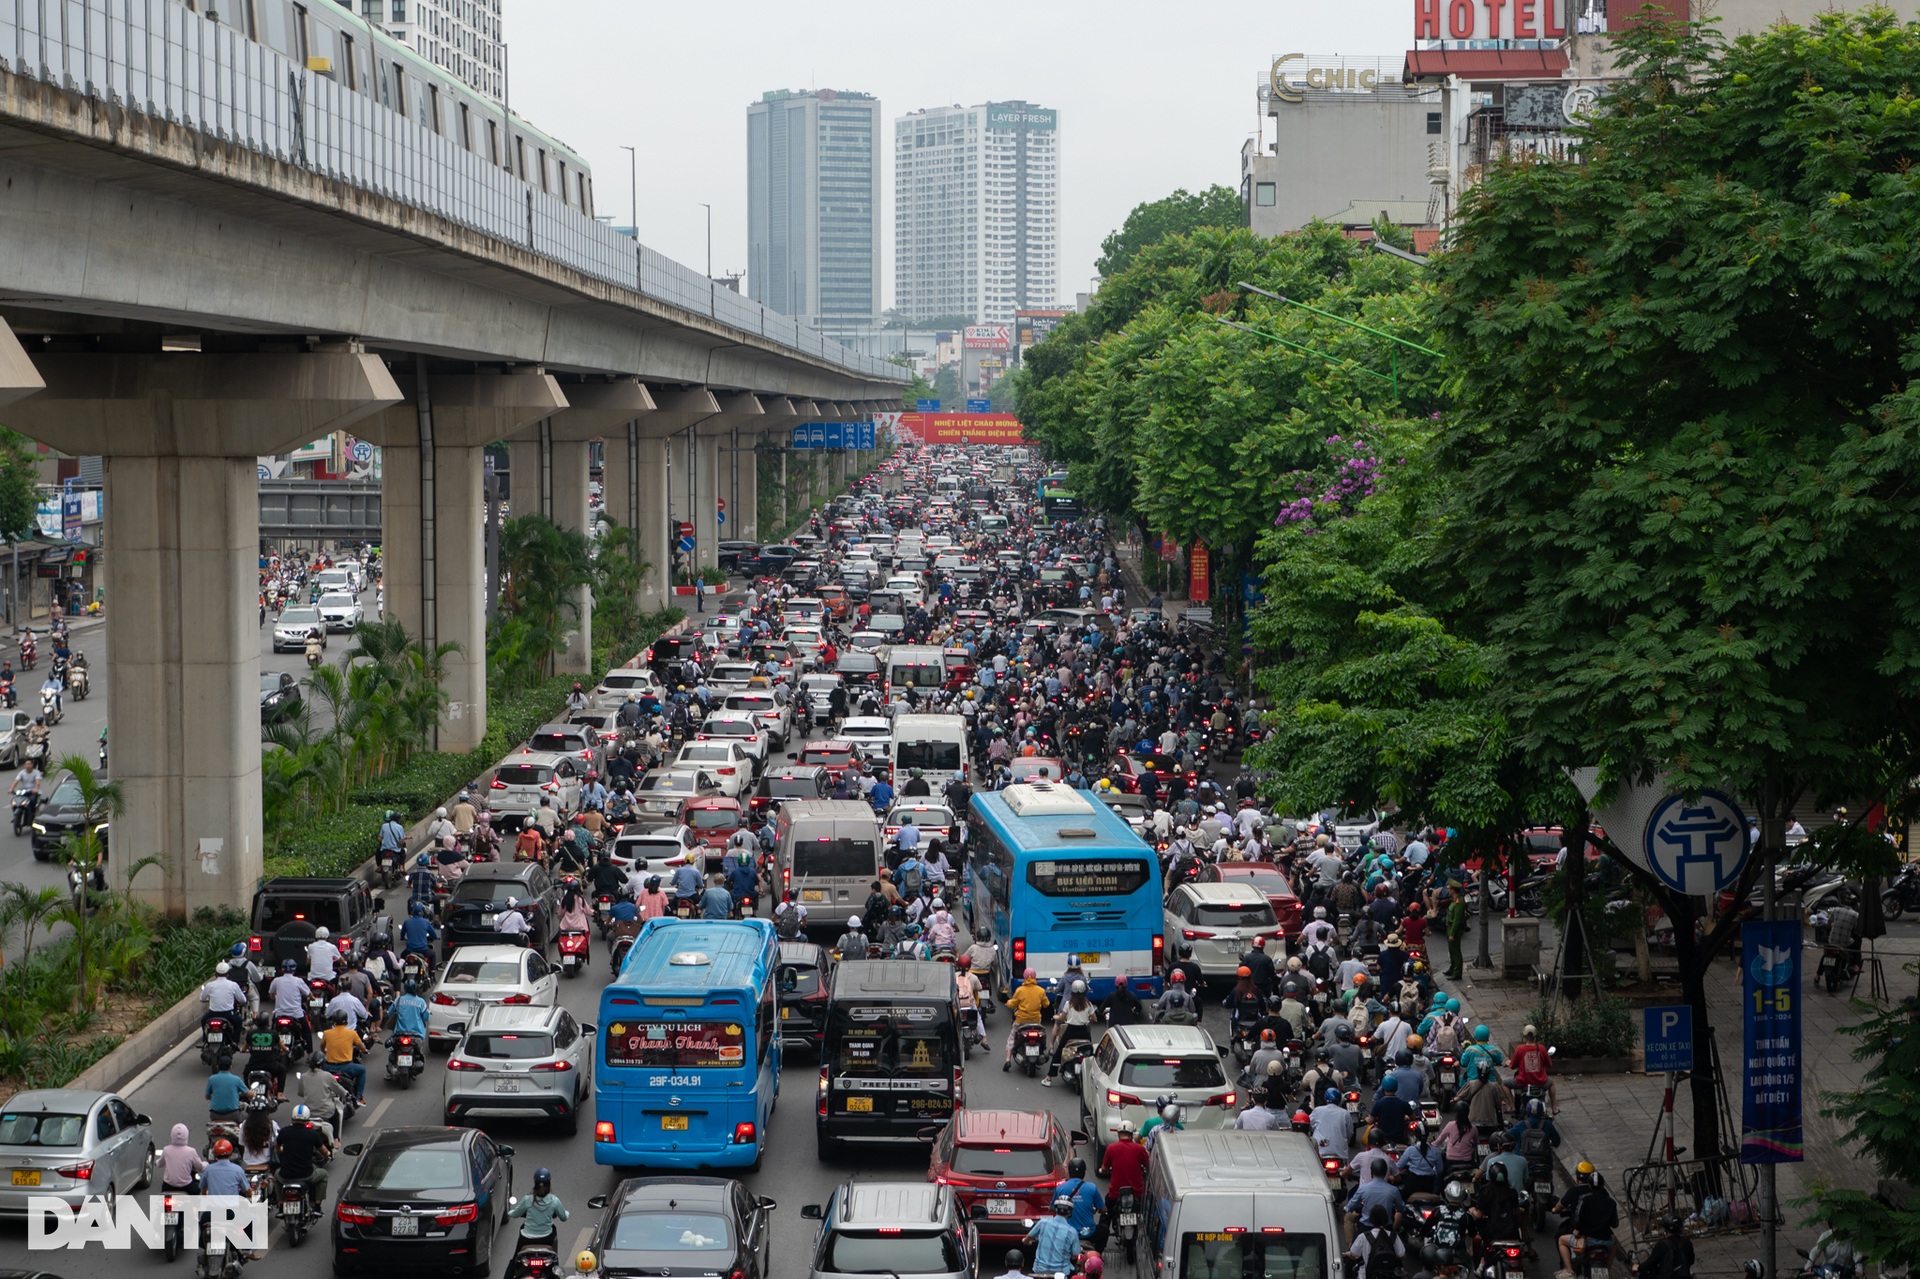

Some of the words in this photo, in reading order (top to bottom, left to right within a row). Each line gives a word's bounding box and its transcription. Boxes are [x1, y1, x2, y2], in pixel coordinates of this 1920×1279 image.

[1415, 0, 1565, 39] HOTEL
[1306, 68, 1376, 88] CHIC
[991, 113, 1020, 122] LAYER
[1023, 114, 1052, 123] FRESH
[934, 419, 955, 427] NHIỆT
[957, 419, 972, 427] LIỆT
[1057, 877, 1073, 886] BUS
[1753, 988, 1790, 1013] 1-5
[677, 1024, 701, 1033] LỊCH
[1662, 1011, 1679, 1037] P
[252, 1033, 273, 1046] 3D
[1756, 1039, 1769, 1049] TINH
[1647, 1043, 1654, 1051] XE
[1669, 1042, 1676, 1050] XE
[1767, 1054, 1786, 1068] QUỐC
[650, 1076, 701, 1086] 29F-034.91
[1750, 1076, 1762, 1087] LAO
[1762, 1073, 1781, 1087] ĐỘNG
[1783, 1074, 1794, 1085] 1/5
[911, 1100, 952, 1109] 29G-024.53
[1205, 1233, 1216, 1242] HỢP
[1217, 1233, 1233, 1241] ĐỒNG
